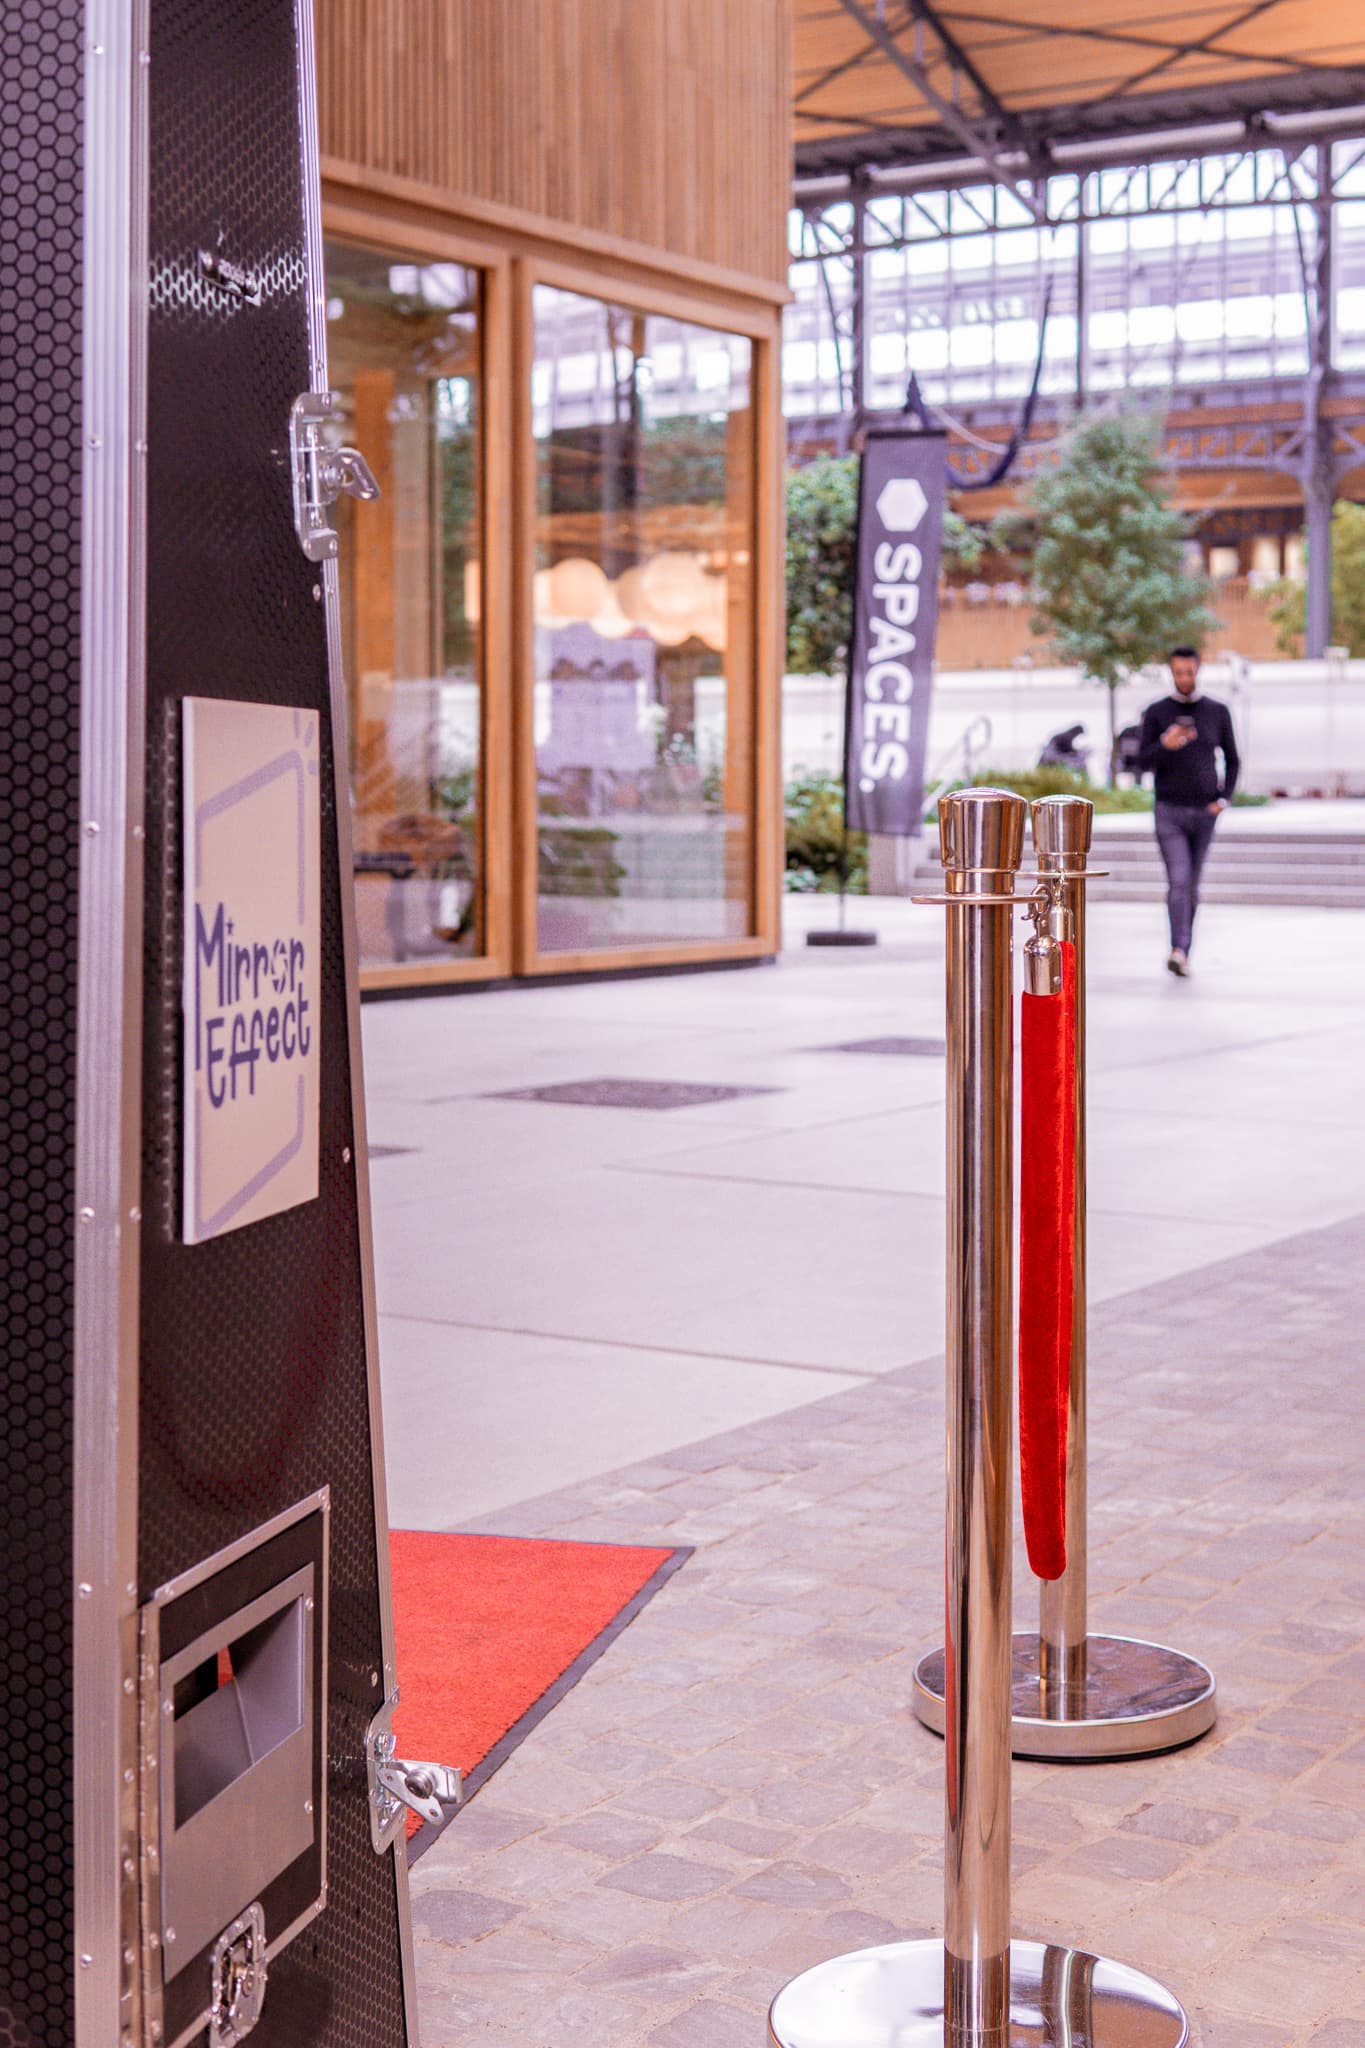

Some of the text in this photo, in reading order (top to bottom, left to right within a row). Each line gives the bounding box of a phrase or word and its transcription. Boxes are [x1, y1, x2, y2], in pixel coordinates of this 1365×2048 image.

[859, 542, 922, 793] SPACES.
[195, 902, 305, 1070] Mirror
[206, 982, 310, 1109] Effect
